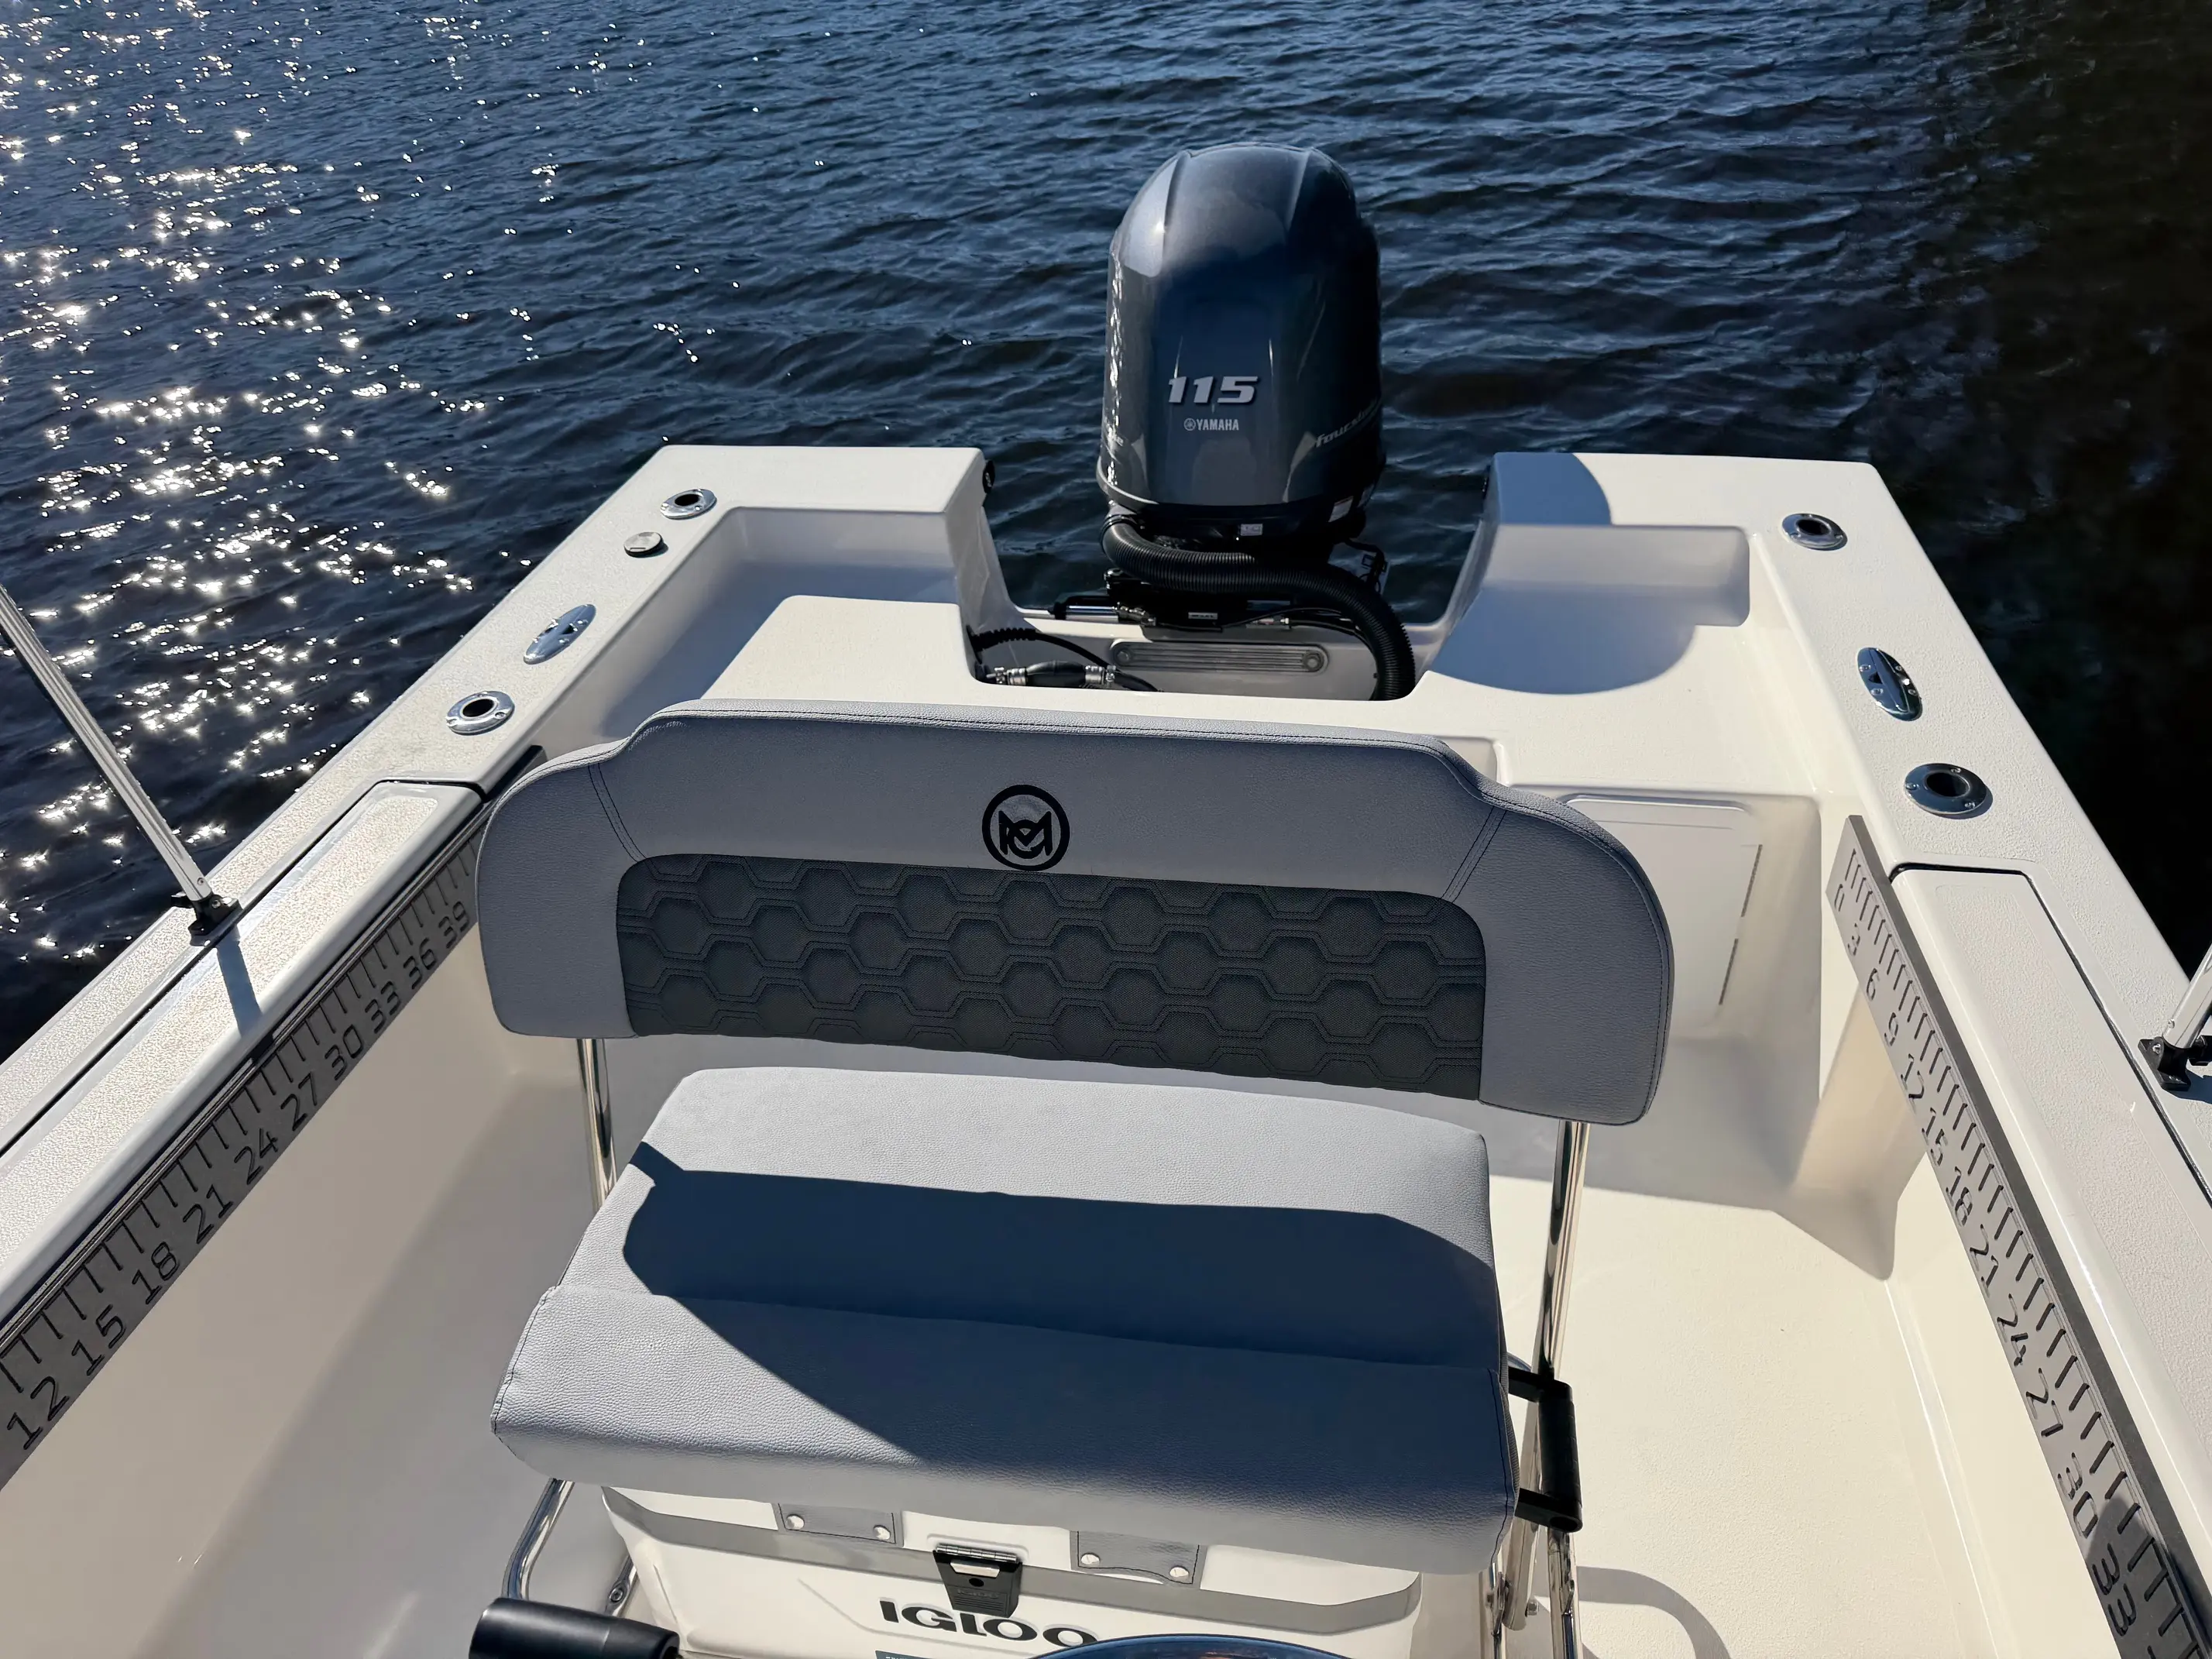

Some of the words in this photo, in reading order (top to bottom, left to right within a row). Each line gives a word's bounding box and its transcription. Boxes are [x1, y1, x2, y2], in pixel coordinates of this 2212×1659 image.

[1168, 376, 1259, 404] 115
[1196, 418, 1239, 431] YAMAHA
[6, 1376, 70, 1450] 12
[71, 1304, 126, 1376] 15
[132, 1241, 180, 1305] 18
[183, 1184, 234, 1245] 21
[233, 1128, 279, 1186] 24
[280, 1073, 318, 1132] 27
[324, 1024, 365, 1081] 30
[365, 981, 403, 1035] 33
[403, 938, 437, 991] 36
[438, 901, 471, 950] 39
[1847, 922, 1860, 956] 3
[1866, 967, 1881, 1001] 6
[1884, 1012, 1898, 1046] 9
[1901, 1053, 1925, 1114] 12
[1921, 1107, 1948, 1166] 15
[1945, 1166, 1973, 1228] 18
[1969, 1223, 1999, 1298] 21
[1996, 1293, 2028, 1367] 24
[2025, 1367, 2064, 1437] 27
[2056, 1451, 2099, 1540] 30
[2092, 1542, 2137, 1637] 33
[879, 1600, 1098, 1647] IGLOO
